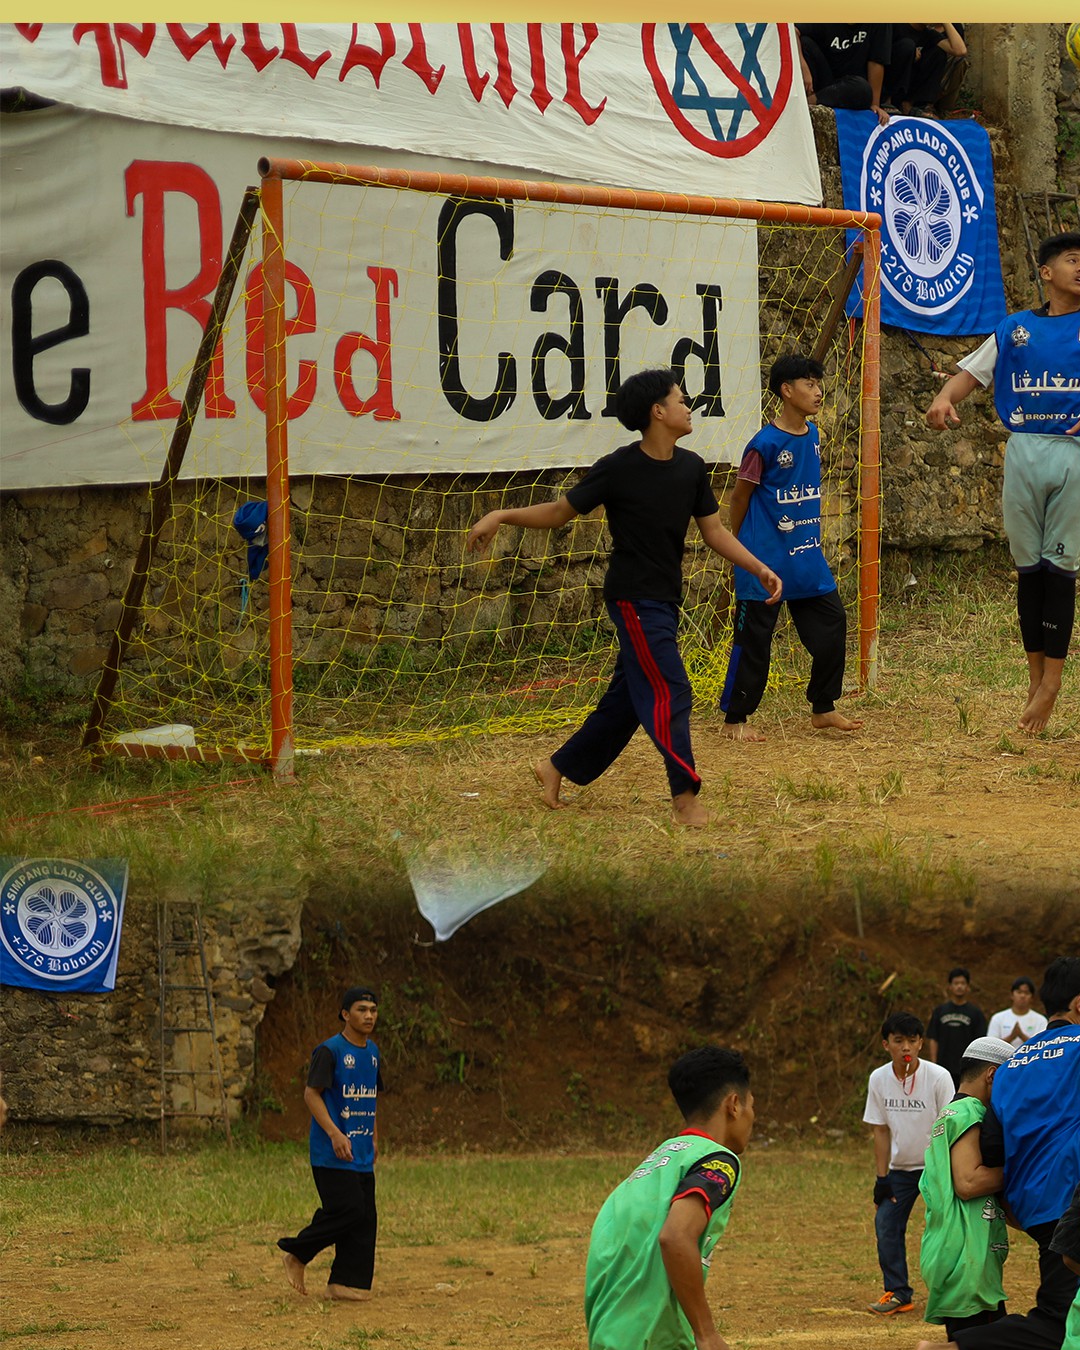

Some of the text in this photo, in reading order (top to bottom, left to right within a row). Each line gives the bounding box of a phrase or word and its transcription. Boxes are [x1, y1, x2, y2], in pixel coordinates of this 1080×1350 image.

[871, 128, 971, 201] SIMPANG LADS CLUB
[124, 159, 401, 423] Red
[437, 195, 726, 422] Card
[915, 252, 975, 303] Bobotoh
[1025, 412, 1067, 420] BRONTO
[7, 865, 107, 910] SIMPANG LADS CLUB
[47, 939, 105, 973] Bobotoh
[1042, 1048, 1064, 1059] CLUB
